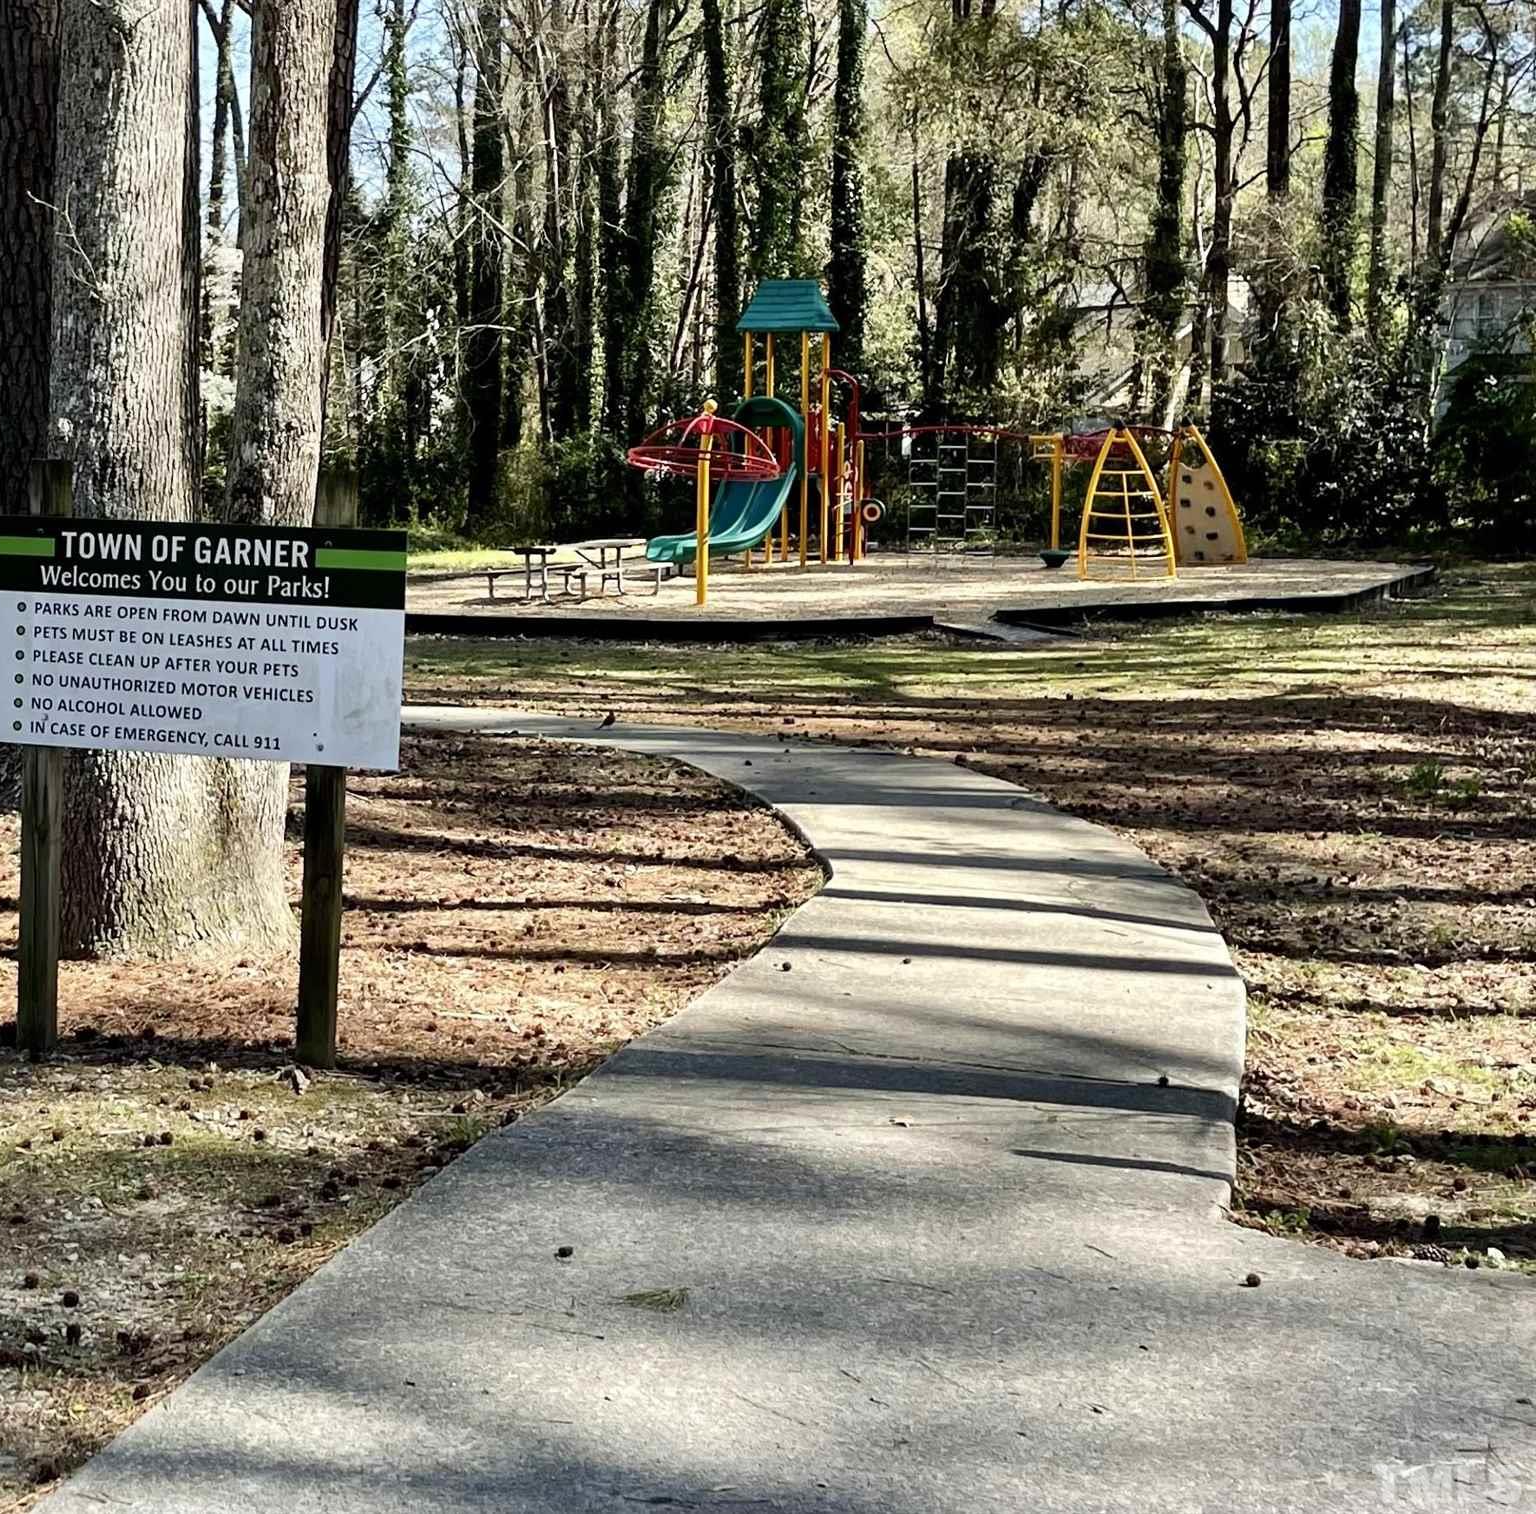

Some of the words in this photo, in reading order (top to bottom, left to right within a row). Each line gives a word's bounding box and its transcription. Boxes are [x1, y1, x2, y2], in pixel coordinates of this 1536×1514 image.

[62, 532, 141, 560] TOWN
[152, 535, 185, 561] OF
[195, 538, 308, 567] GARNER
[41, 566, 140, 589] Welcomes
[148, 570, 187, 592] You
[196, 574, 216, 593] to
[224, 578, 259, 595] our
[268, 576, 329, 598] Parks!
[34, 601, 80, 617] PARKS
[83, 604, 113, 618] ARE
[117, 606, 158, 621] OPEN
[162, 608, 207, 623] FROM
[212, 610, 261, 626] DAWN
[266, 613, 311, 629] UNTIL
[316, 616, 358, 632] DUSK
[33, 625, 68, 640] PETS
[72, 627, 115, 643] MUST
[119, 630, 137, 644] BE
[141, 631, 165, 645] ON
[169, 632, 233, 649] LEASHES
[236, 636, 256, 651] AT
[259, 638, 287, 653] ALL
[291, 639, 339, 655] TIMES
[33, 649, 84, 665] PLEASE
[88, 652, 134, 668] CLEAN
[140, 655, 161, 669] UP
[164, 656, 211, 673] AFTER
[215, 659, 258, 676] YOUR
[263, 662, 299, 678] PETS
[32, 673, 54, 687] NO
[58, 674, 176, 695] UNAUTHORIZED
[181, 682, 238, 699] MOTOR
[242, 685, 314, 703] VEHICLES
[31, 697, 53, 711] NO
[57, 698, 126, 716] ALCOHOL
[129, 703, 203, 721] ALLOWED
[30, 720, 46, 734] IN
[50, 722, 86, 737] CASE
[90, 724, 110, 739] OF
[114, 726, 209, 748] EMERGENCY,
[213, 733, 249, 748] CALL
[253, 735, 281, 751] 911
